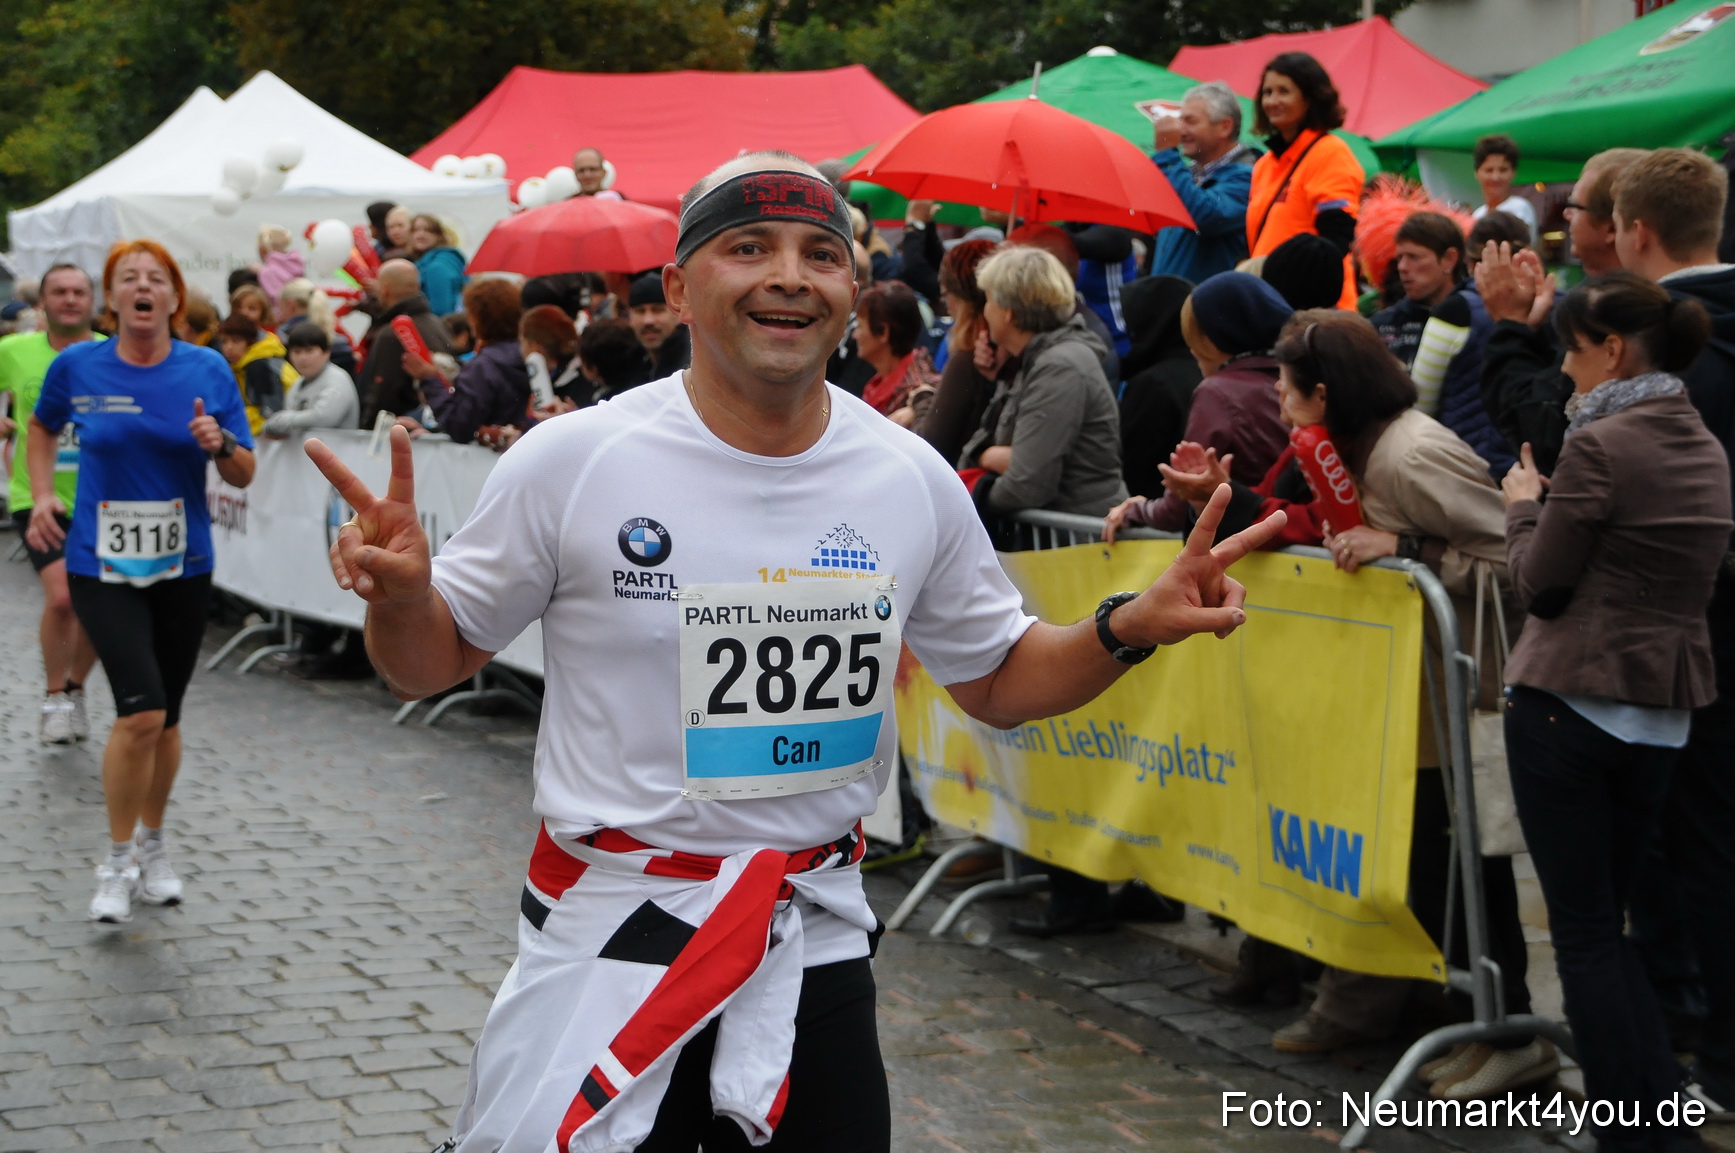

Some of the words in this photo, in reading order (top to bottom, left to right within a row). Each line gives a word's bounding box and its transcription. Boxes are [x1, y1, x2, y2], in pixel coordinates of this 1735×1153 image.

[109, 521, 180, 553] 3118
[622, 518, 667, 537] BMW
[612, 570, 678, 589] PARTL
[757, 567, 788, 583] 14
[788, 567, 853, 580] Neumarkter
[614, 586, 679, 602] Neumark
[685, 605, 761, 626] PARTL
[767, 602, 868, 623] Neumarkt
[706, 632, 882, 715] 2825
[691, 712, 700, 725] D
[772, 735, 821, 766] Can
[1268, 801, 1363, 899] KANN
